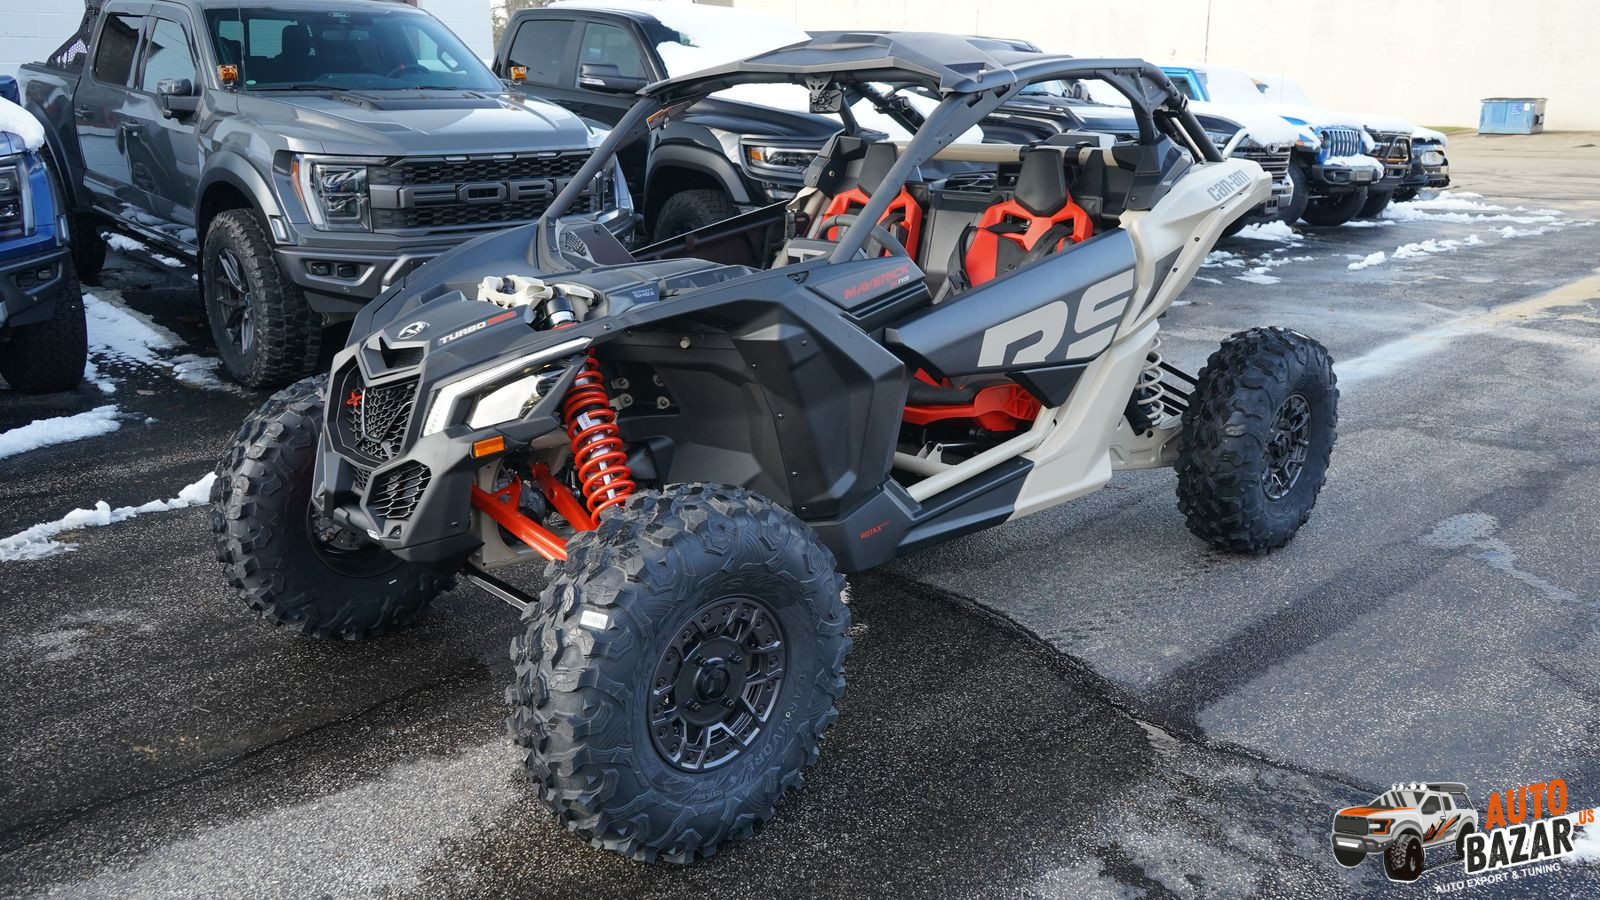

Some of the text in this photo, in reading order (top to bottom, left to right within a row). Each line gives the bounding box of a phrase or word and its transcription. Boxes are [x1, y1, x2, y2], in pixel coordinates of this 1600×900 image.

[1206, 170, 1251, 202] can-am
[843, 262, 911, 299] MAVERICK
[439, 321, 487, 345] TURBO
[977, 268, 1135, 368] RS
[860, 526, 882, 541] ROTAX
